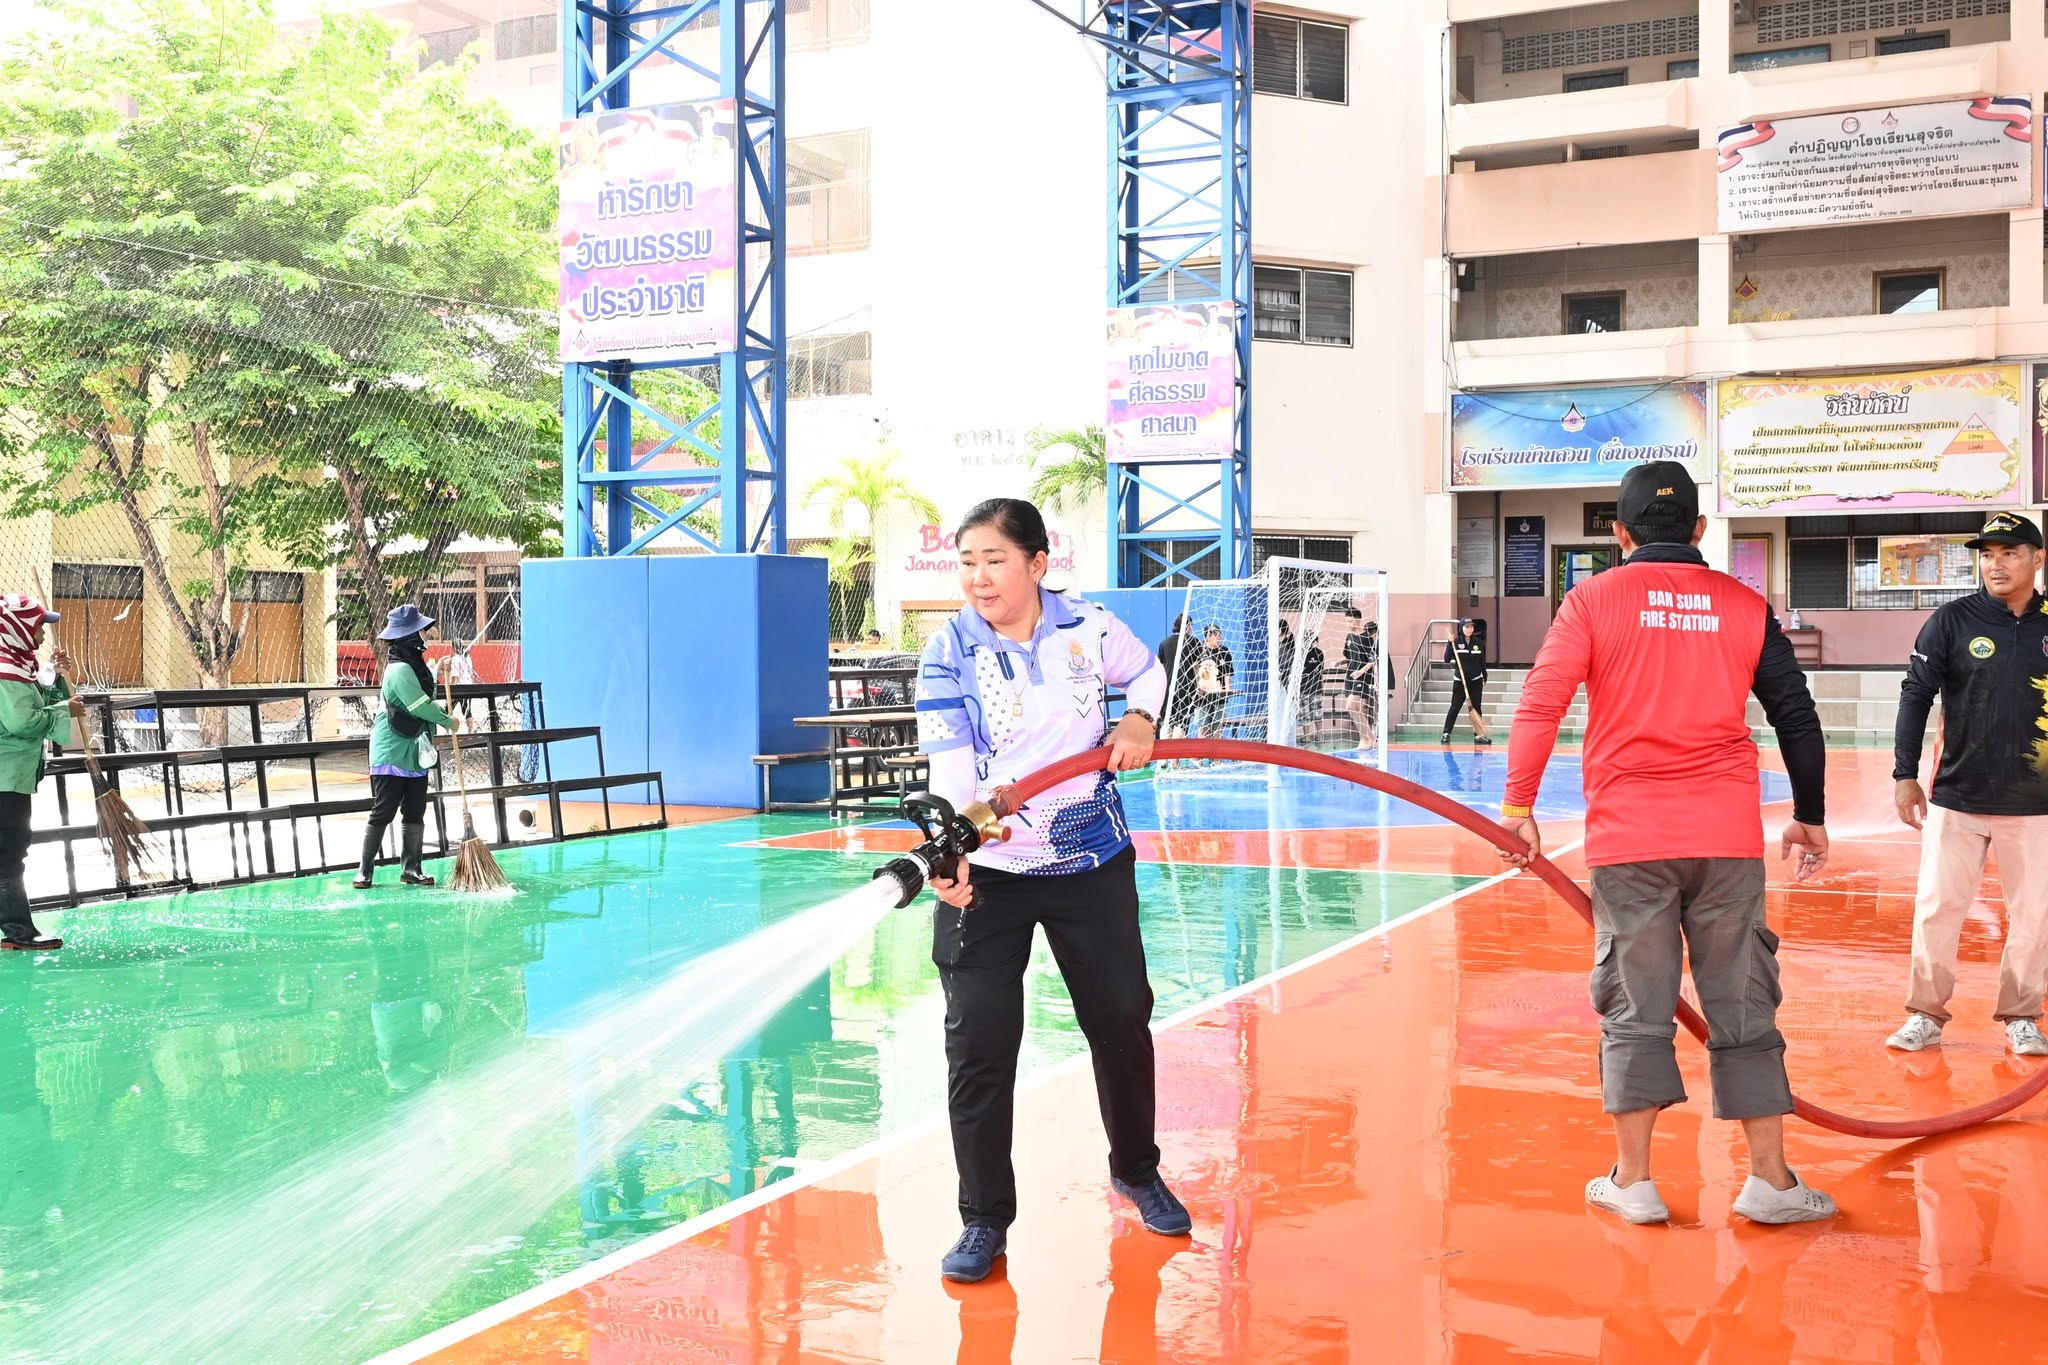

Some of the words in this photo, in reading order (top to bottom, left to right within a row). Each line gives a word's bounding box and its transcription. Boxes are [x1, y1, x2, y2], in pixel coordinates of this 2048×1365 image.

[1789, 126, 1953, 155] คำปฏิญญาโรงเรียนสุจริต
[1738, 153, 1959, 182] เราจะร่วมกันป้องกันและต่อต้านการทุจริตทุกรูปแบบ
[1738, 161, 2020, 195] เราจะปลูกฝังค่านิยมความซื่อสัตย์สุจริตระหว่างโรงเรียนและชุมชน
[598, 178, 694, 217] ห้ารักษา
[1738, 174, 2018, 208] เราจะสร้างเครือข่ายความซื่อสัตย์สุจริตระหว่างโรงเรียนและชุมชน
[1738, 200, 1874, 221] ให้เป็นรูปธรรมและมีความยั่งยืน
[576, 228, 713, 267] วัฒนธรรม
[582, 275, 705, 318] ประจำชาติ
[1129, 343, 1209, 371] หกไม่ขาด
[1128, 380, 1206, 403] ศีลธรรม
[1824, 384, 1912, 416] วิสัยทัศน์
[1141, 415, 1197, 434] ศาสนา
[1461, 444, 1590, 467] โรงเรียนบ้านสวน
[1656, 486, 1674, 497] AEK
[1647, 590, 1674, 608] BAN
[1676, 593, 1712, 611] SUAN
[1640, 610, 1666, 628] FIRE
[1668, 613, 1720, 633] STATION
